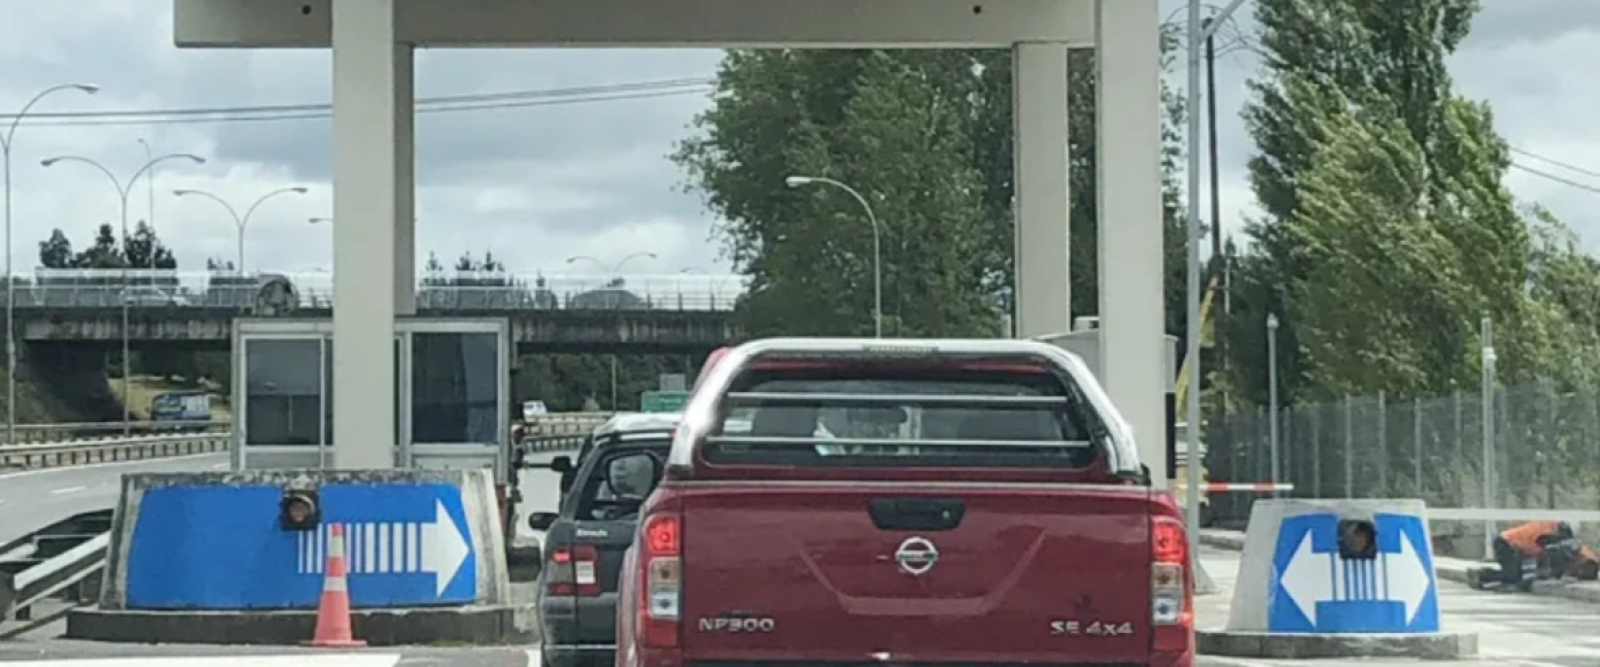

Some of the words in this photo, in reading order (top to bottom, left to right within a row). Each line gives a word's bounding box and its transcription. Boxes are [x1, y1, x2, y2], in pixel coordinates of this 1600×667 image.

[699, 618, 775, 632] NP300
[1050, 621, 1081, 634] SE
[1086, 621, 1133, 635] 4x4
